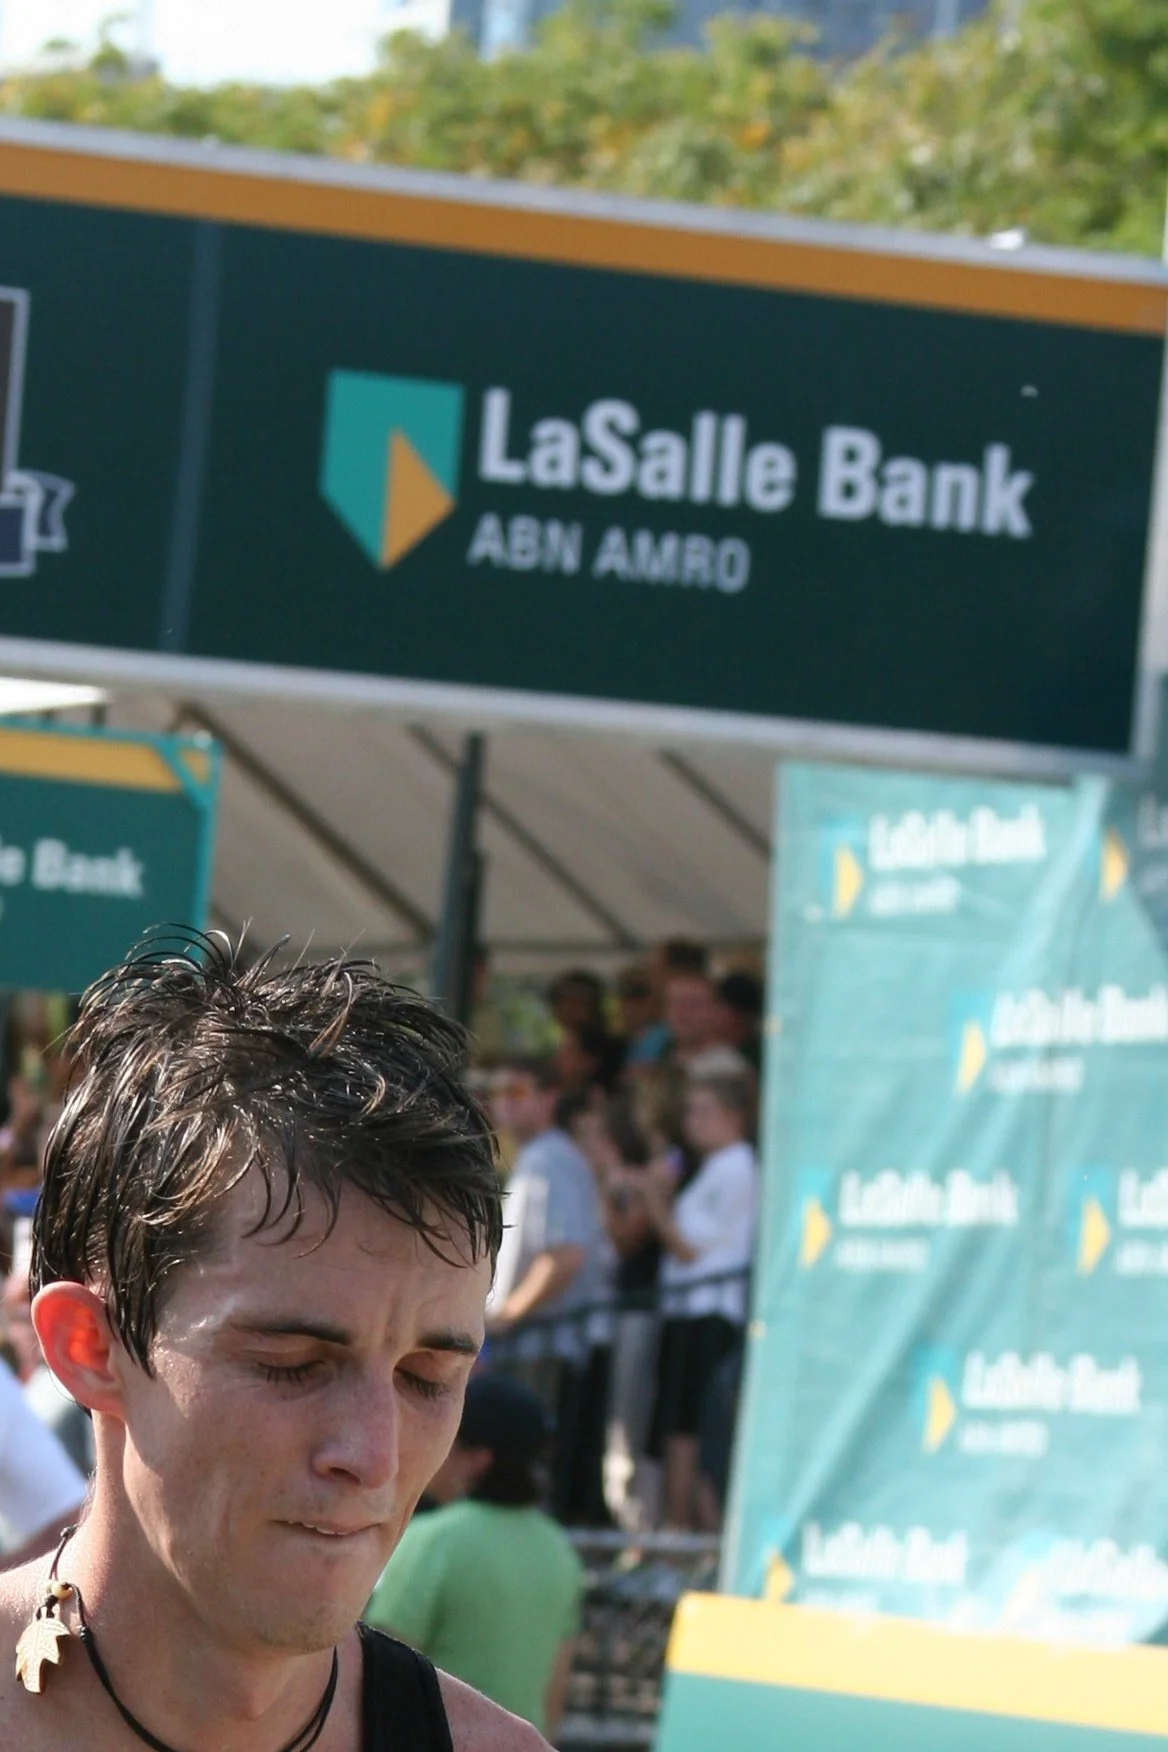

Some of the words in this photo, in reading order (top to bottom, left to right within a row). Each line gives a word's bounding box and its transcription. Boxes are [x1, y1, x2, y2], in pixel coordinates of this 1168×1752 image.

[479, 386, 796, 513] LaSalle
[819, 424, 1035, 540] Bank
[467, 512, 581, 576] ABN
[594, 528, 751, 595] AMRO
[32, 836, 144, 899] Bank
